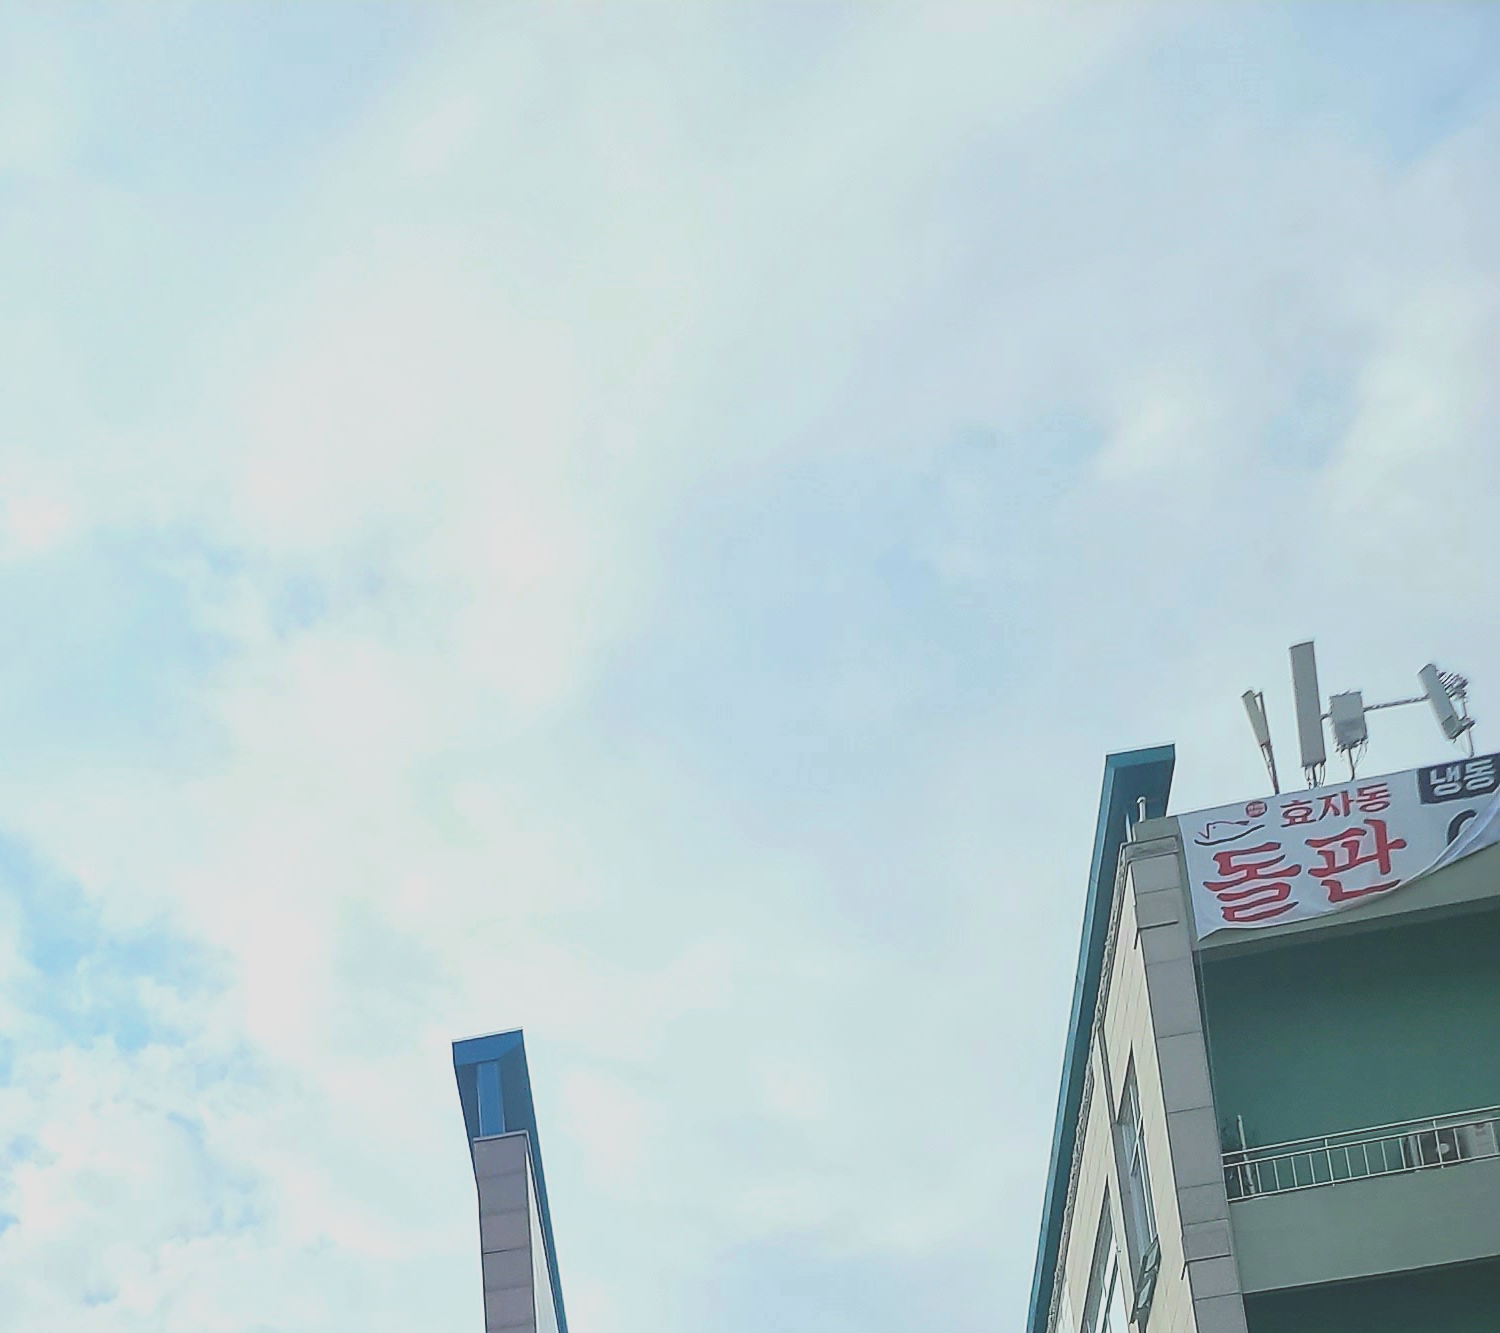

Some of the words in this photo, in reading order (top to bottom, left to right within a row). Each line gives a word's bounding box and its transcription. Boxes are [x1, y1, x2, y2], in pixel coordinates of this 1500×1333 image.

[1430, 758, 1495, 797] 냉동
[1280, 782, 1392, 828] 효자동
[1203, 819, 1407, 922] 돌판
